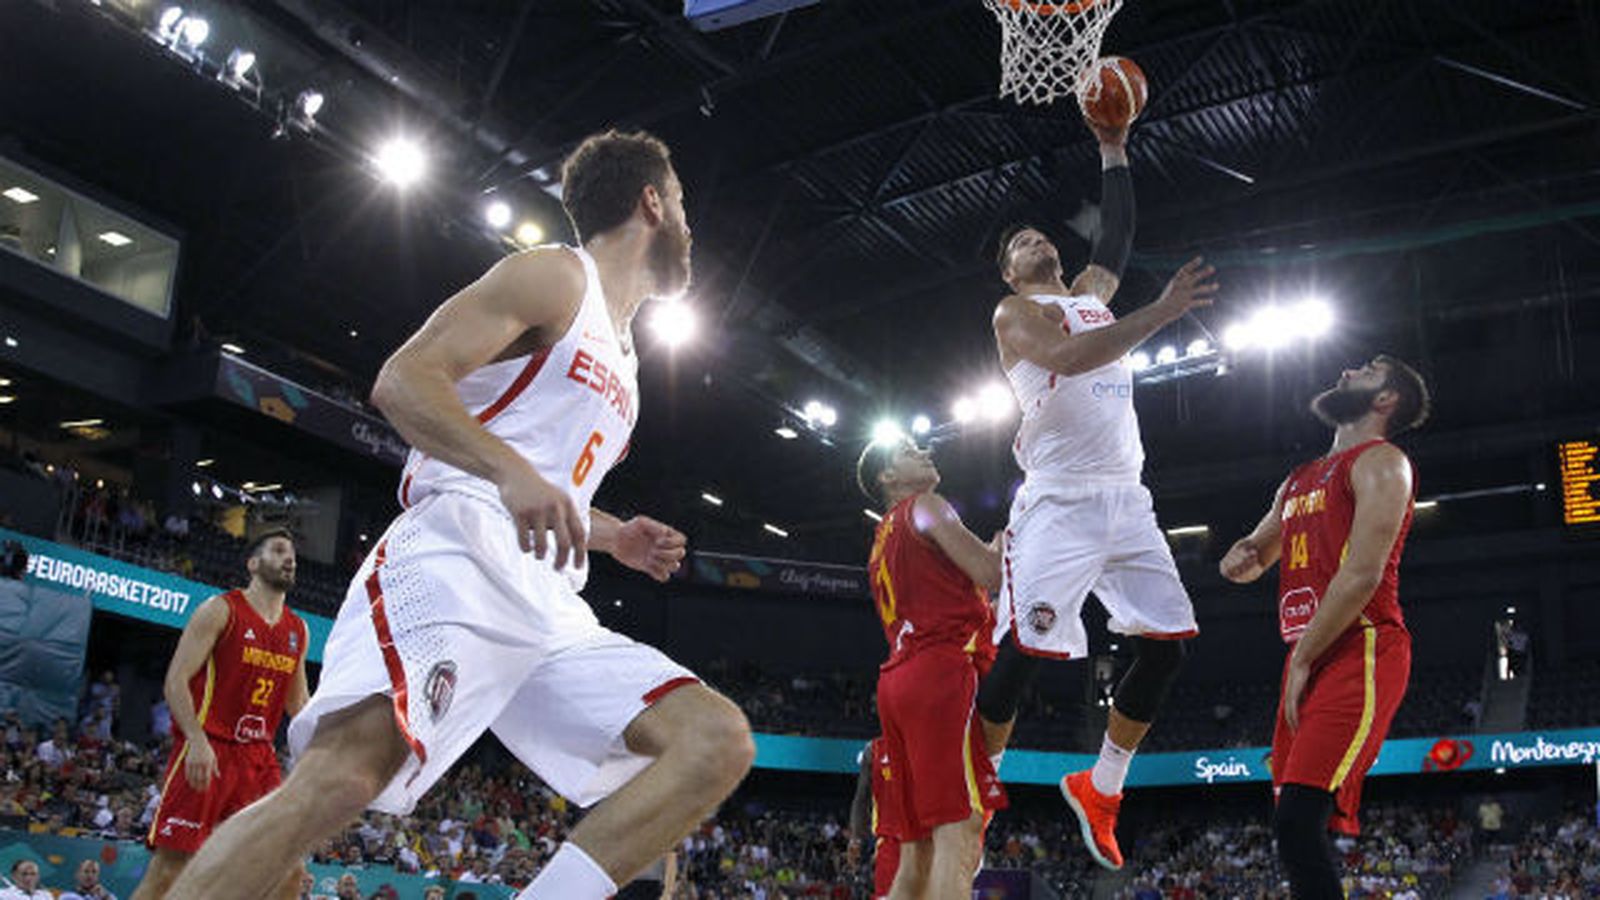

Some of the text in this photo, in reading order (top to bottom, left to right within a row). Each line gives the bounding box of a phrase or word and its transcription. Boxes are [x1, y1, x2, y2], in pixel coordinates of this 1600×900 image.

[571, 430, 605, 487] 6
[1289, 531, 1309, 570] 14
[26, 554, 190, 615] #EUROBASKET2017
[1195, 756, 1251, 784] Spain
